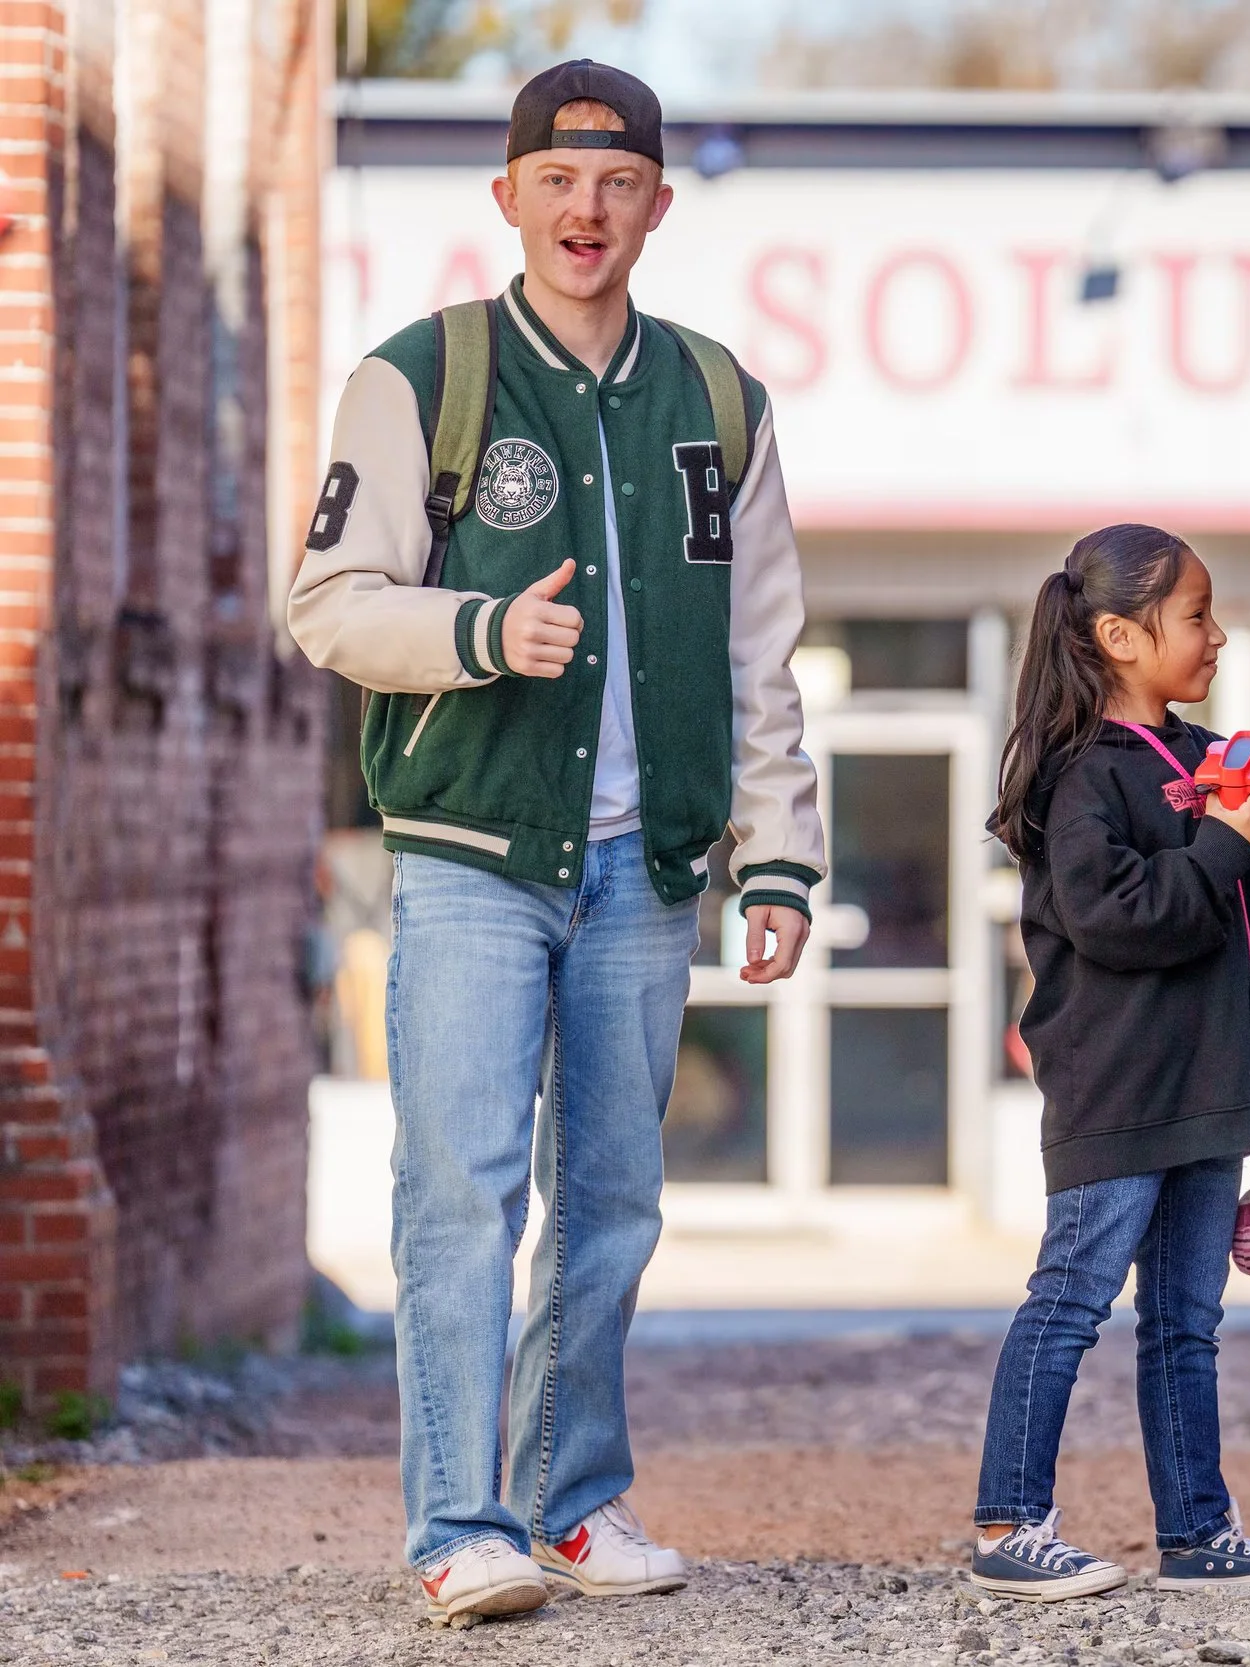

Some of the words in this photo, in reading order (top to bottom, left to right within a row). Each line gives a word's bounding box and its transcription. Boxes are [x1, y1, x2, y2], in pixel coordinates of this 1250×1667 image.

[485, 445, 548, 475] HAWKINS
[479, 490, 500, 519] HIGH
[502, 494, 548, 523] SCHOOL
